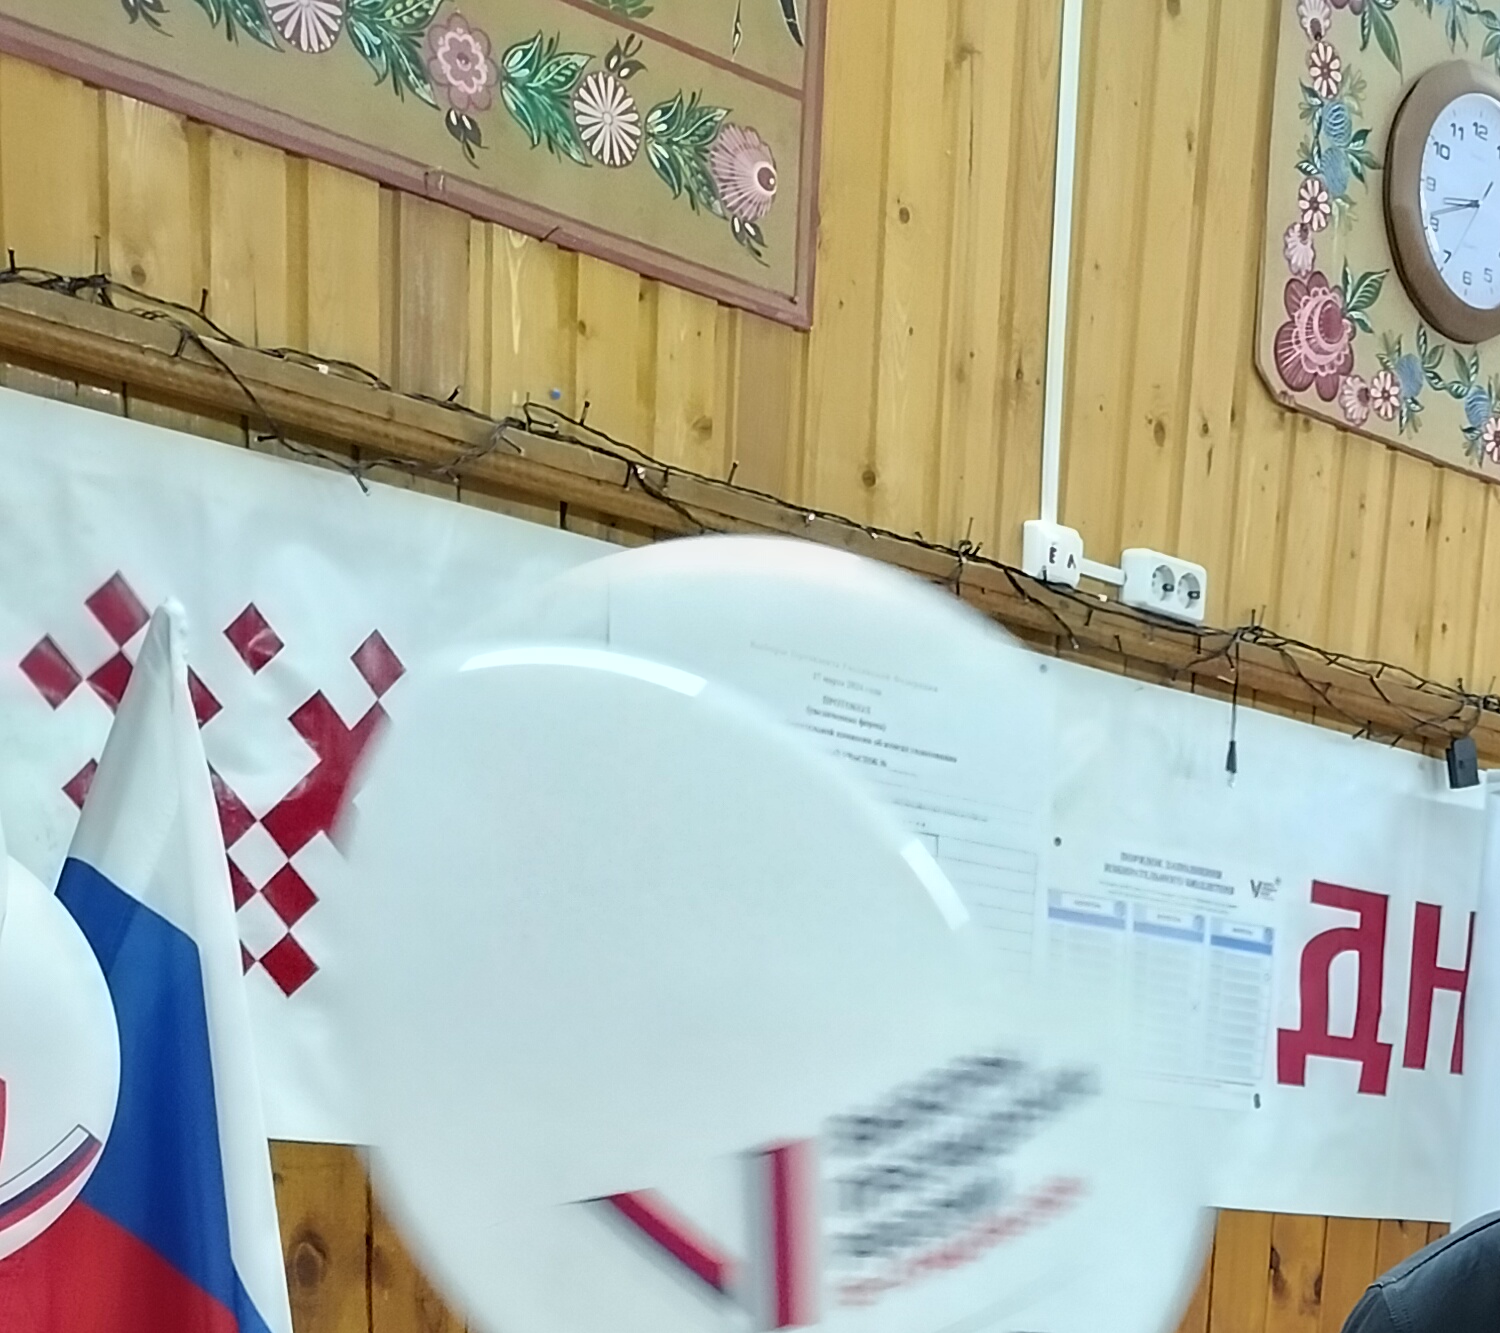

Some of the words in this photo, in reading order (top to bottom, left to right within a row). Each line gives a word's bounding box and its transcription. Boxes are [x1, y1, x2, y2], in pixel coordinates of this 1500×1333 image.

[1449, 122, 1465, 142] 11
[1472, 121, 1489, 142] 12
[1432, 141, 1451, 161] 10
[1425, 175, 1437, 192] 9
[1442, 249, 1453, 264] 7
[1462, 270, 1473, 286] 6
[1483, 267, 1494, 284] 5
